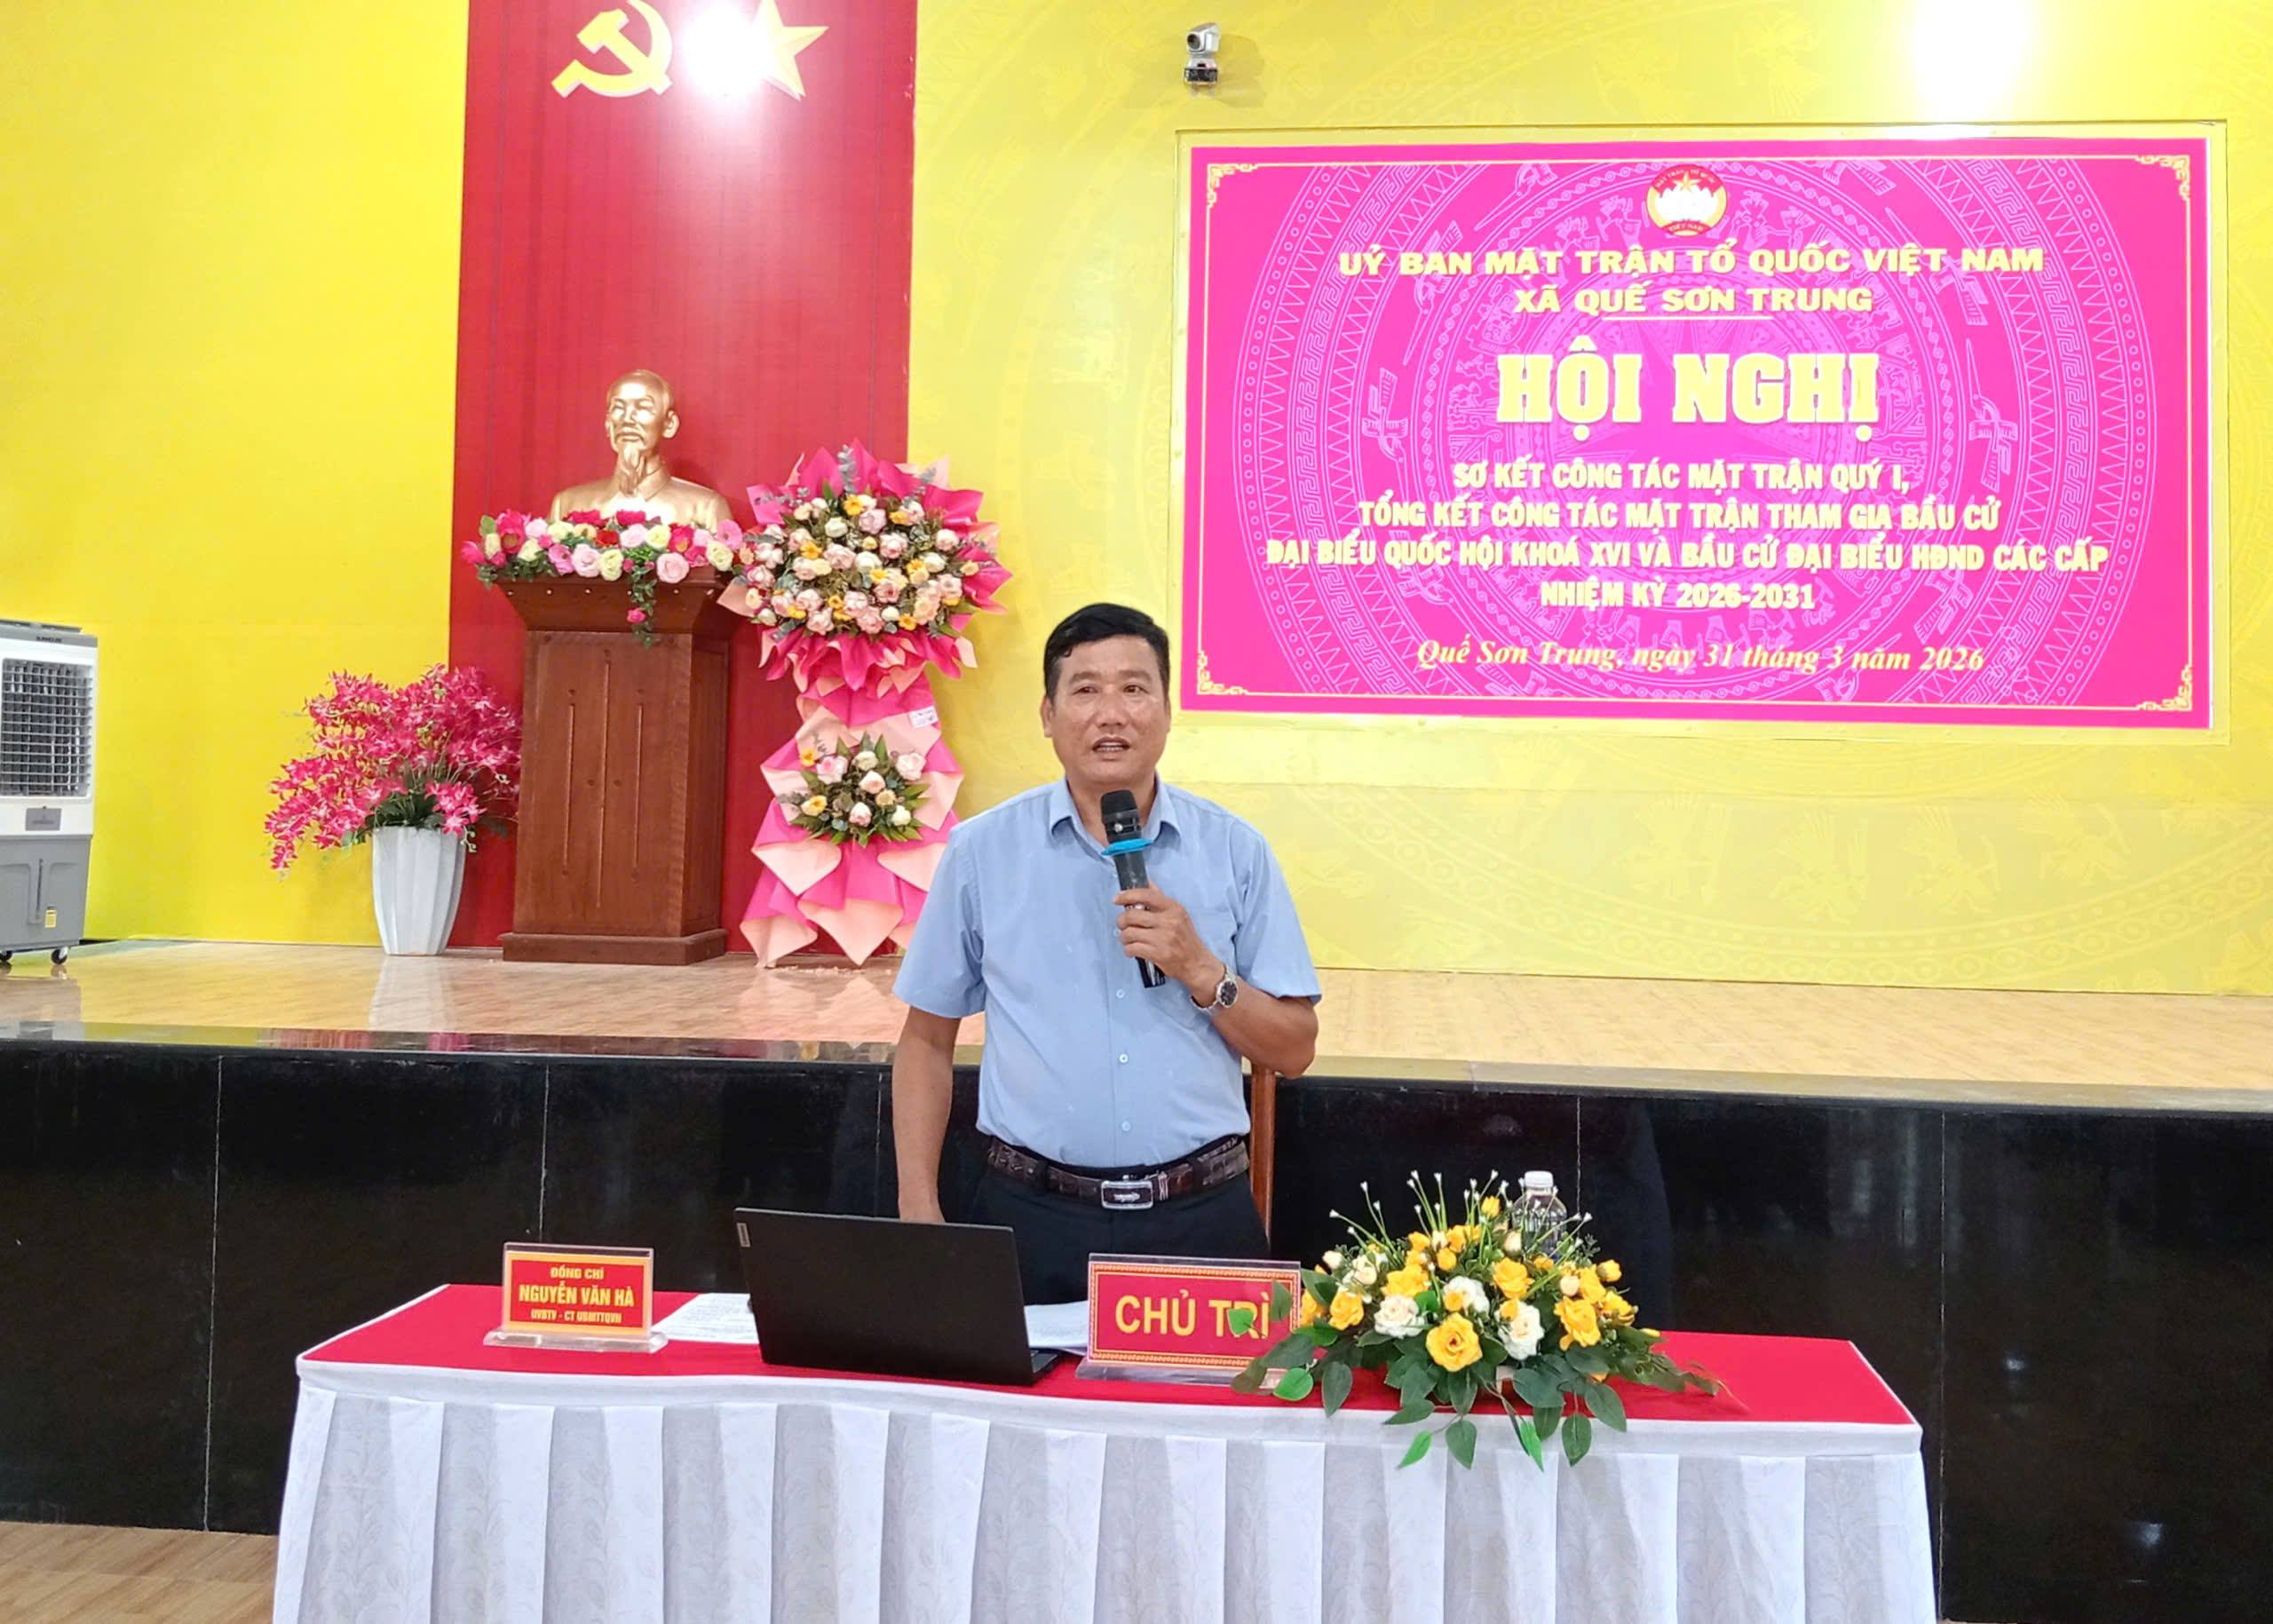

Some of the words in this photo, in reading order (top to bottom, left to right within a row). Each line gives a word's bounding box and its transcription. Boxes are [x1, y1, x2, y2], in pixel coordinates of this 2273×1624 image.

[1340, 244, 1386, 277] UỶ
[1400, 252, 1473, 276] BAN
[1485, 248, 1564, 280] MẶT
[1577, 245, 1675, 279] TRẬN
[1688, 239, 1738, 274] TỔ
[1749, 242, 1852, 278] QUỐC
[1863, 242, 1948, 278] VIỆT
[1961, 248, 2045, 273] NAM
[1515, 285, 1562, 314] XÃ
[1574, 281, 1651, 316] QUẾ
[1662, 286, 1736, 313] SƠN
[1747, 287, 1873, 313] TRUNG
[1496, 336, 1643, 441] HỘI
[1673, 353, 1881, 443] NGHỊ
[1454, 461, 1490, 489] SƠ
[1494, 455, 1547, 489] KẾT
[1552, 458, 1623, 490] CÔNG
[1629, 458, 1681, 490] TÁC
[1689, 461, 1746, 495] MẶT
[1753, 459, 1824, 494] TRẬN
[1831, 457, 1884, 494] QUÝ
[1893, 465, 1911, 494] I,
[1359, 489, 1427, 527] TỔNG
[1434, 494, 1484, 528] KẾT
[1492, 497, 1561, 529] CÔNG
[1568, 497, 1619, 529] TÁC
[1626, 500, 1682, 533] MẶT
[1690, 497, 1761, 533] TRẬN
[1768, 503, 1843, 530] THAM
[1850, 504, 1894, 531] GIA
[1901, 495, 1956, 532] BẦU
[1963, 496, 2001, 532] CỬ
[1267, 539, 1311, 569] ĐẠI
[1318, 529, 1377, 566] BIỂU
[1384, 533, 1453, 570] QUỐC
[1459, 536, 1504, 571] HỘI
[1511, 536, 1581, 568] KHOÁ
[1590, 543, 1632, 568] XVI
[1639, 537, 1673, 567] VÀ
[1682, 533, 1736, 569] BẦU
[1744, 535, 1780, 570] CỬ
[1786, 544, 1833, 574] ĐẠI
[1841, 533, 1905, 571] BIỂU
[1912, 544, 1985, 572] HĐND
[1993, 540, 2047, 573] CÁC
[2055, 537, 2110, 573] CẤP
[1542, 576, 1626, 612] NHIỆM
[1633, 577, 1667, 607] KỲ
[1677, 582, 1816, 610] 2026-2031
[1418, 633, 1471, 670] Quế
[1477, 641, 1529, 666] Sơn
[1541, 642, 1623, 673] Trung,
[1632, 643, 1696, 673] ngày
[1706, 644, 1734, 668] 31
[1743, 646, 1820, 676] tháng
[1828, 646, 1844, 669] 3
[1852, 646, 1912, 670] năm
[1921, 647, 1985, 672] 2026
[519, 1280, 577, 1303] NGUYỄN
[581, 1285, 610, 1306] VĂN
[584, 1267, 604, 1279] CHÍ
[564, 1311, 576, 1322] CT
[1115, 1288, 1196, 1336] CHỦ
